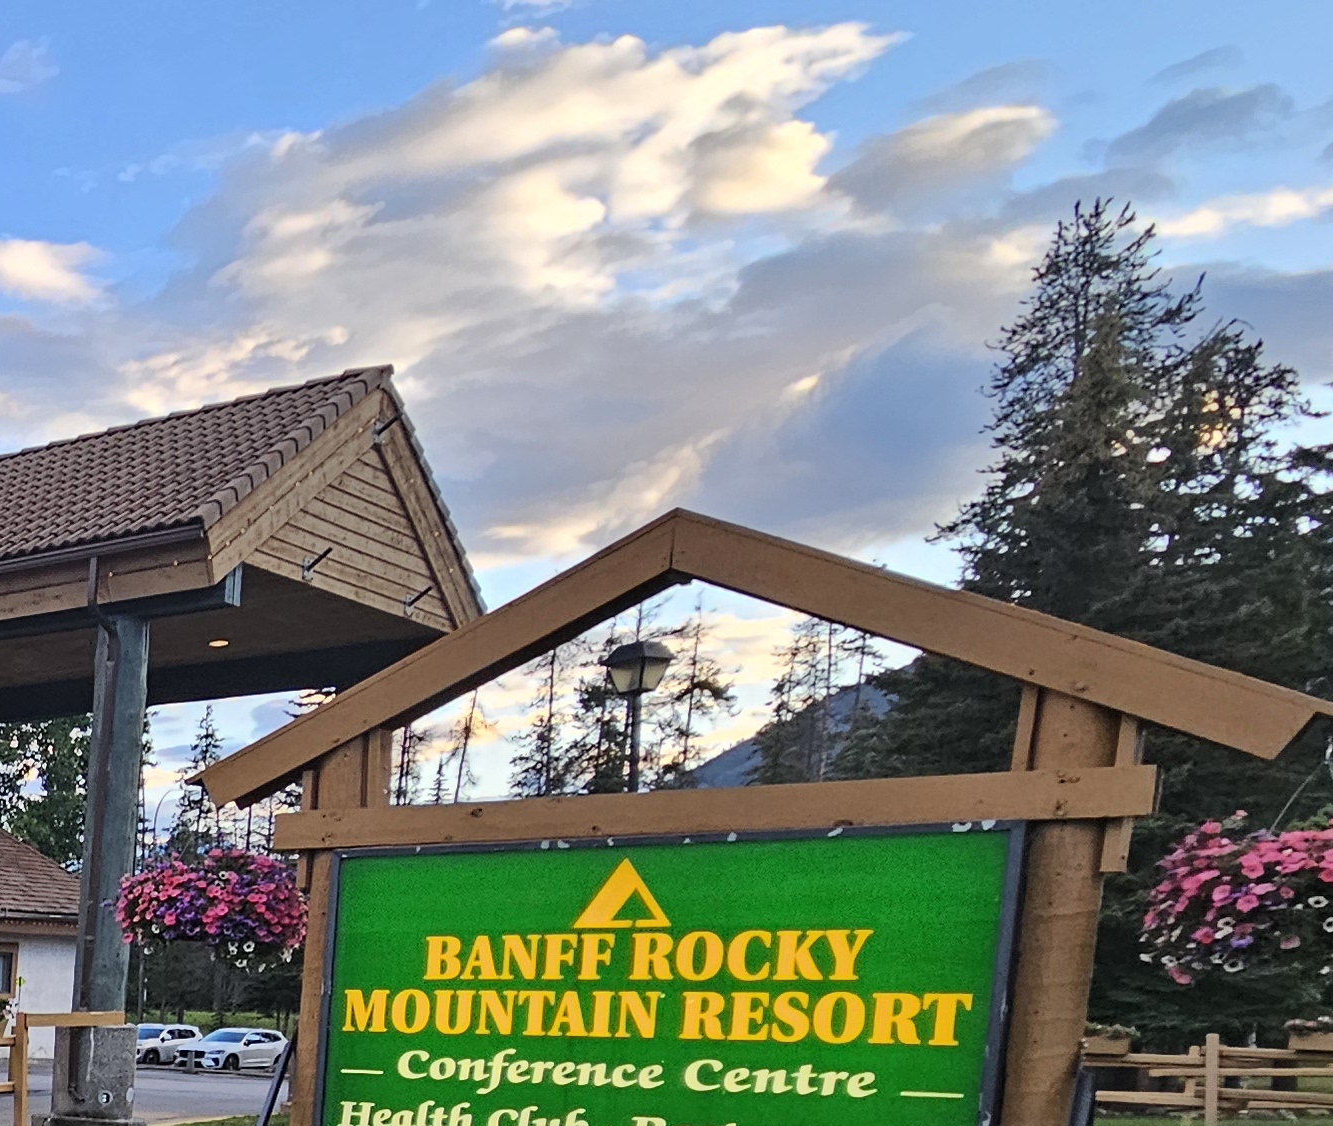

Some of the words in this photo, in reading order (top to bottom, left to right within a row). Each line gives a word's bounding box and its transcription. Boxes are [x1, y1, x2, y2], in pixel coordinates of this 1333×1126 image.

[422, 932, 616, 982] BANFF
[628, 928, 875, 982] ROCKY
[341, 988, 666, 1040] MOUNTAIN
[678, 991, 974, 1047] RESORT
[396, 1047, 666, 1096] Conference
[683, 1057, 879, 1099] Centre
